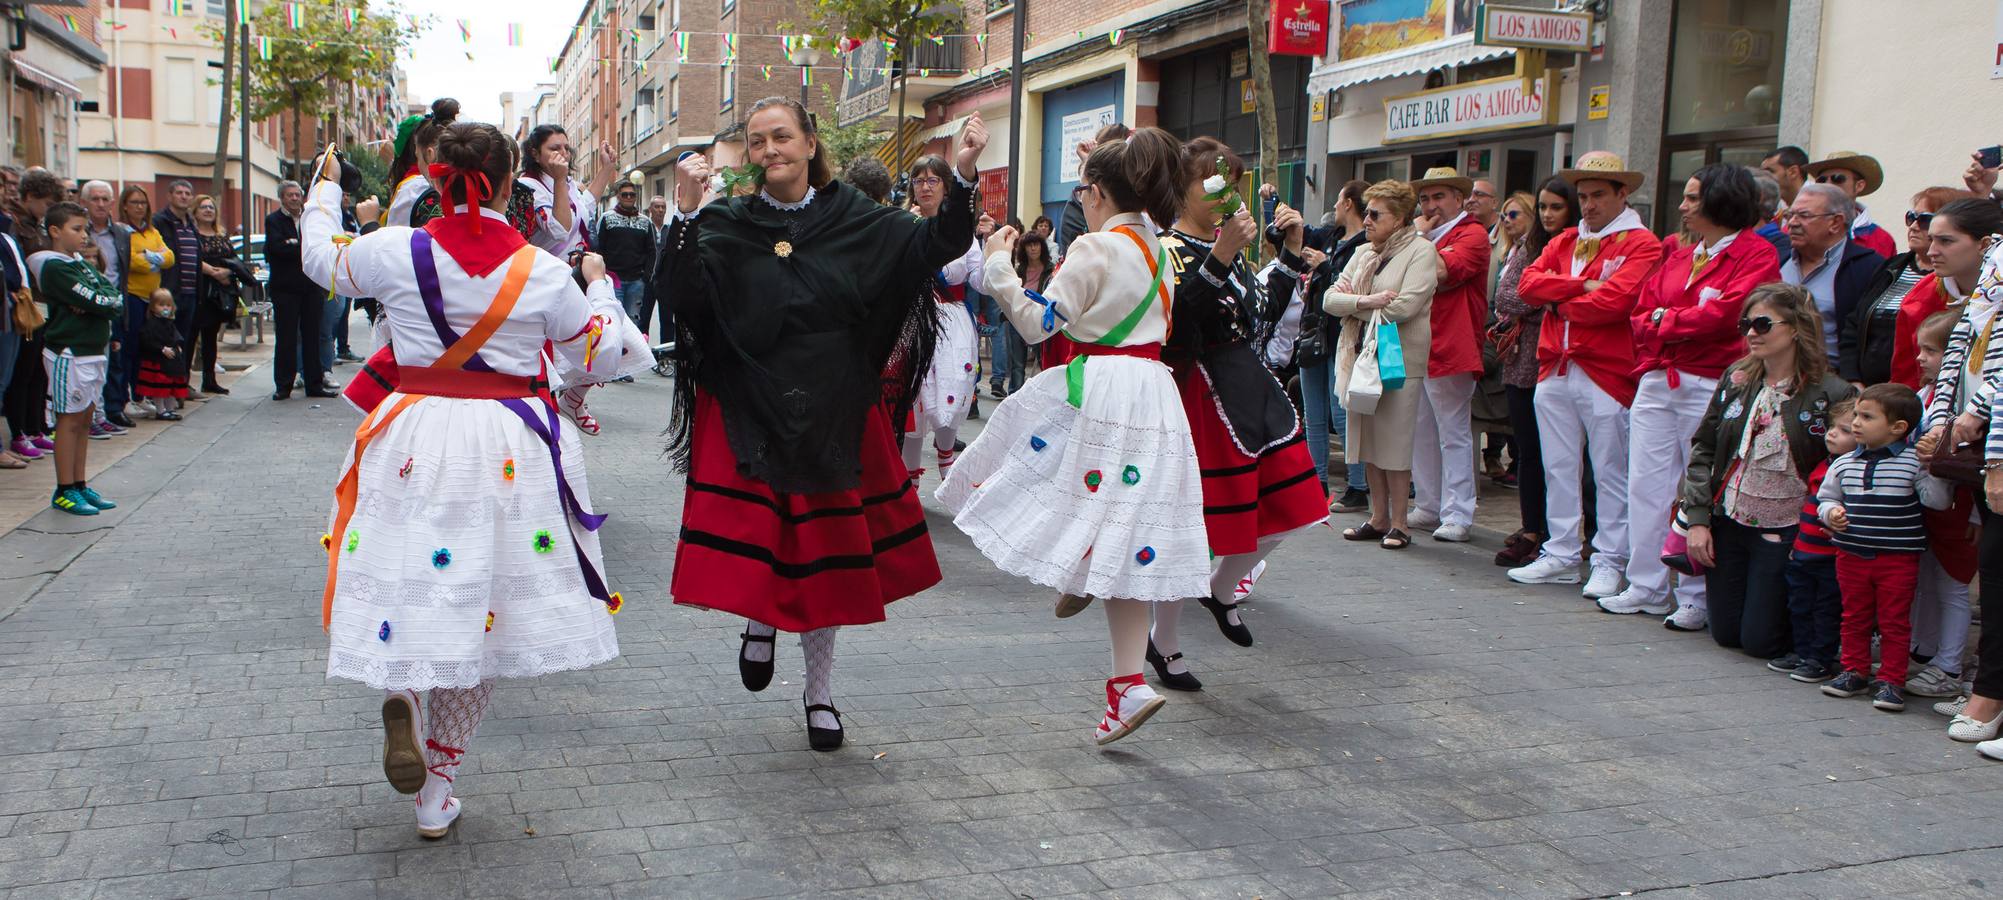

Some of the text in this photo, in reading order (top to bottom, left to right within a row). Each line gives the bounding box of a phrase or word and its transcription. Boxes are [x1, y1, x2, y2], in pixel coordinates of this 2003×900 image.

[1284, 17, 1320, 32] Estrella
[1497, 14, 1582, 41] LOS AMIGOS
[1389, 83, 1542, 132] CAFE BAR LOS AMIGOS
